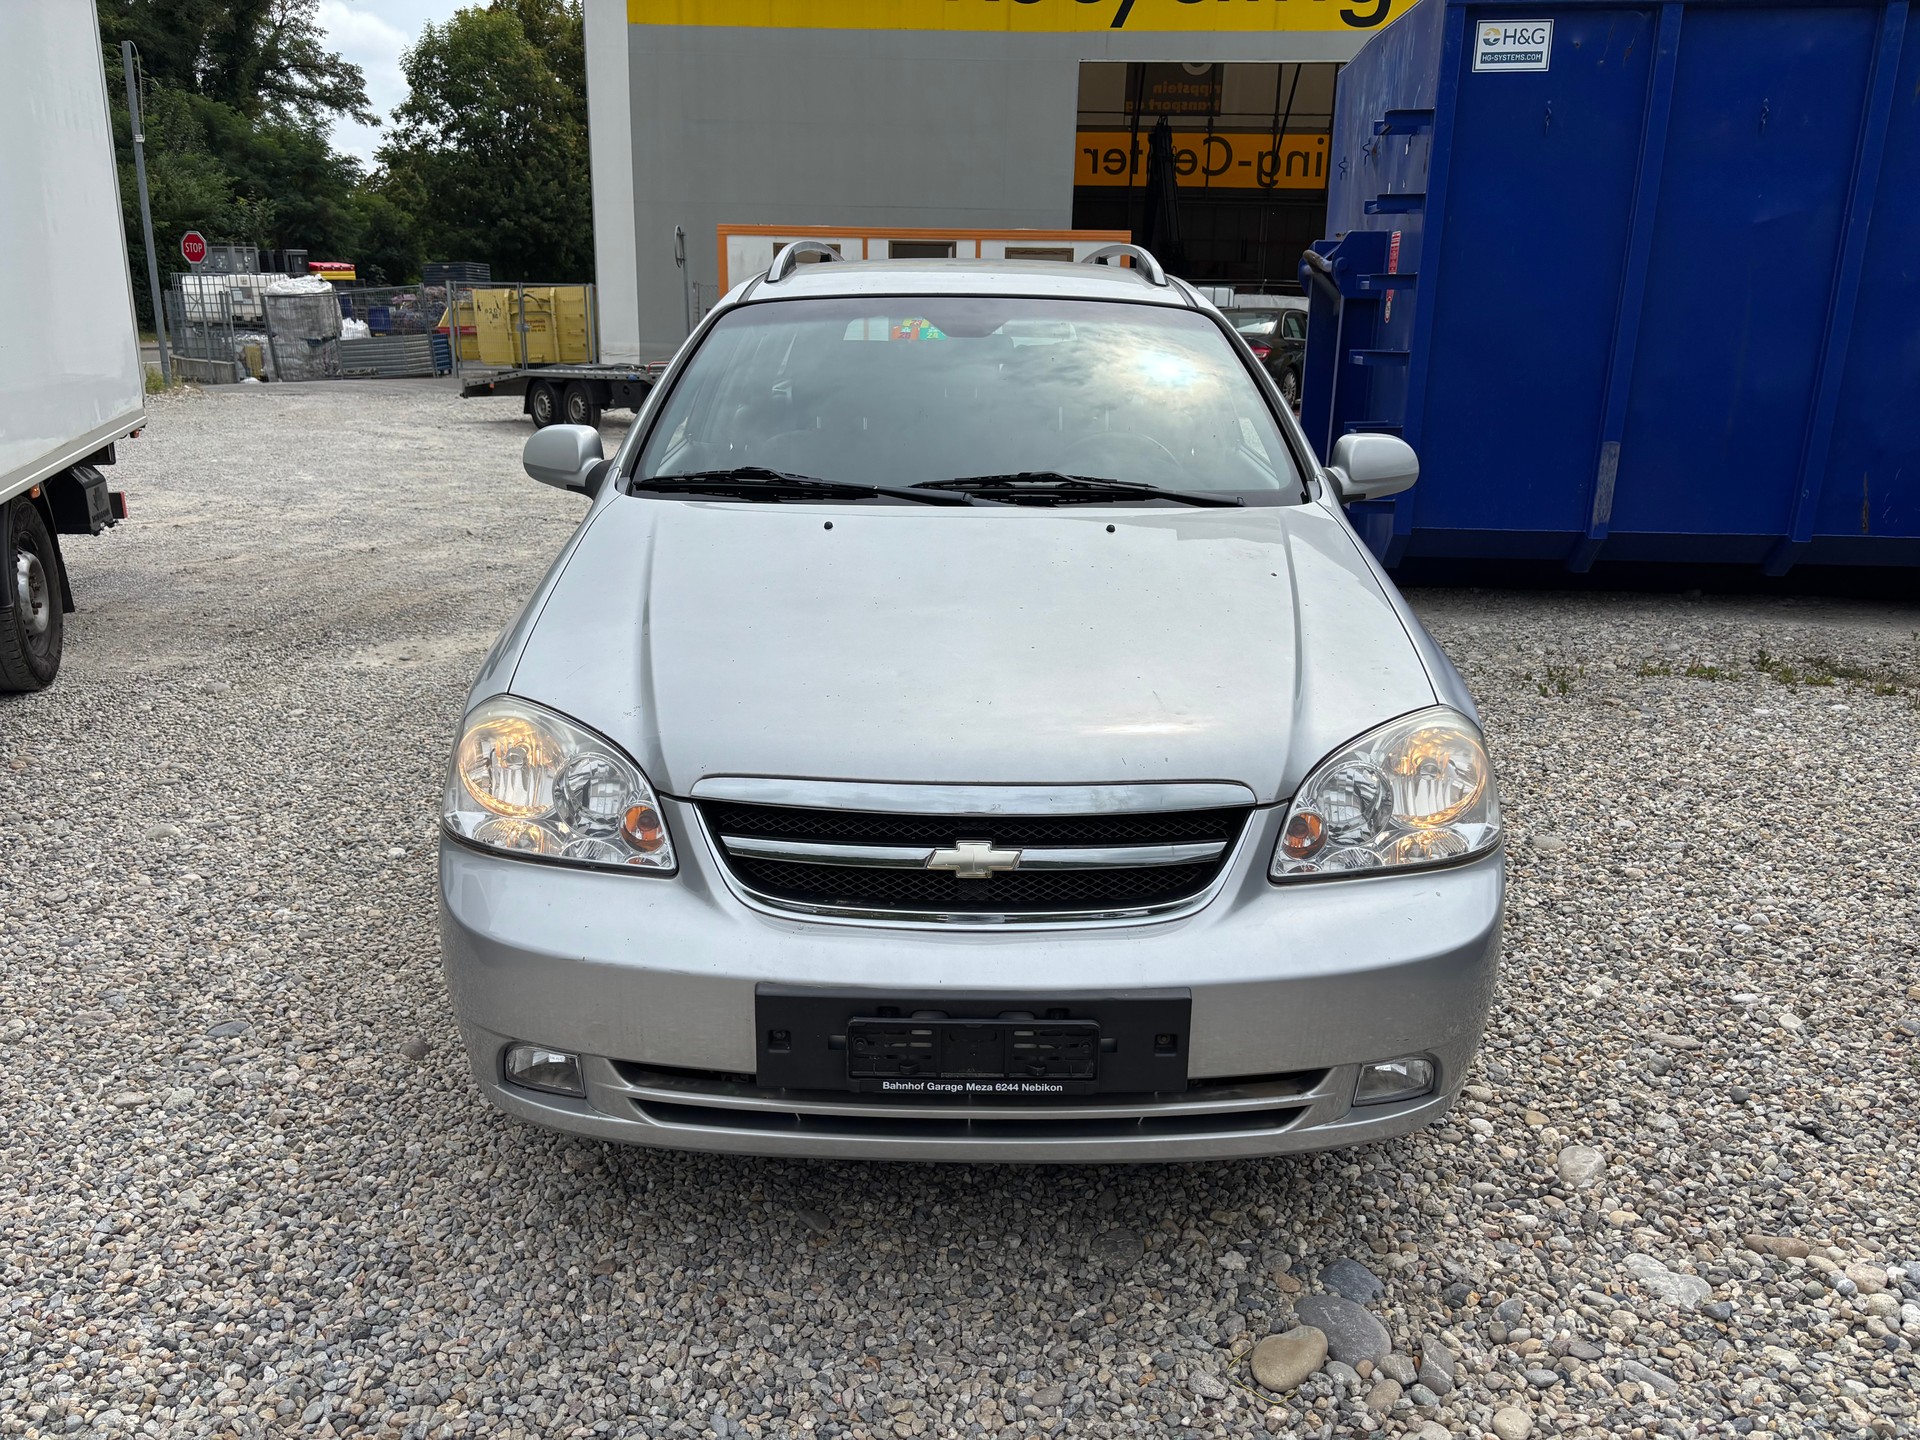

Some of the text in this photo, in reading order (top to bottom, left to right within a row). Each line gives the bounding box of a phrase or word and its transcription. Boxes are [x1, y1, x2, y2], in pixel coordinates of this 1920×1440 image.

[1502, 27, 1546, 45] H&G
[1481, 53, 1542, 62] HG-SYSTEMS.COM
[184, 242, 203, 253] STOP
[882, 1081, 1063, 1093] Bahnhof Garage Meza 6244 Nebikon
